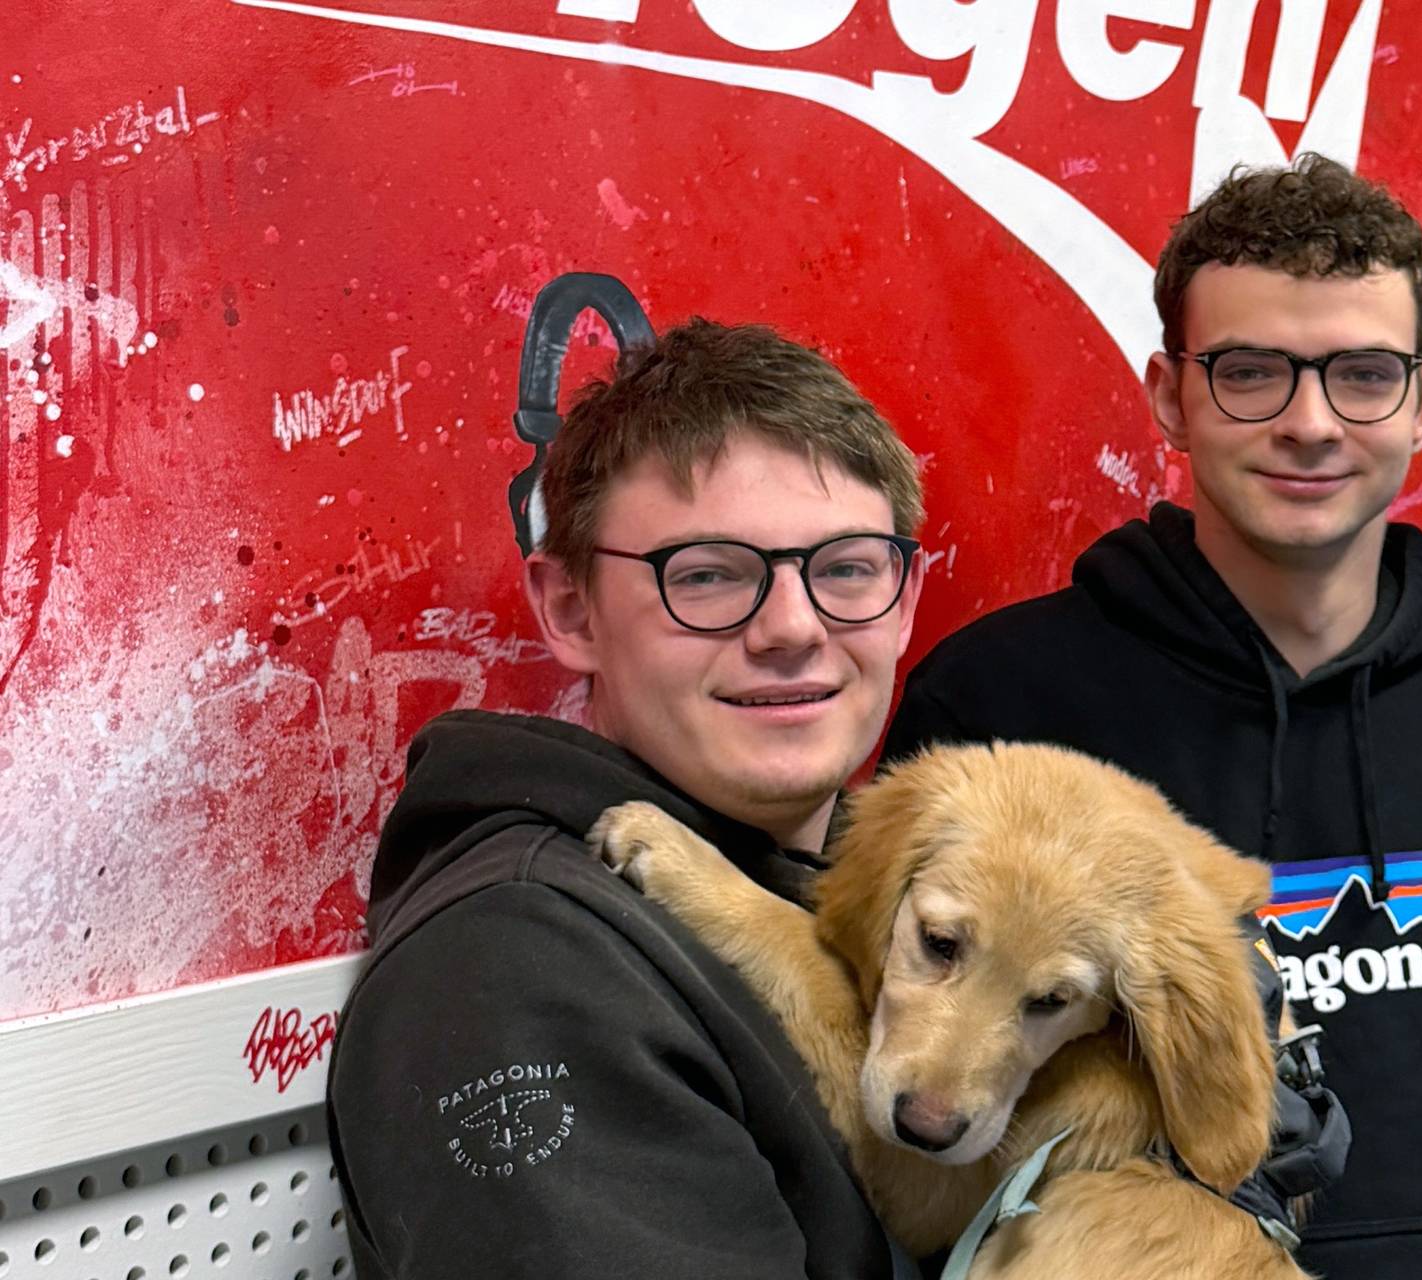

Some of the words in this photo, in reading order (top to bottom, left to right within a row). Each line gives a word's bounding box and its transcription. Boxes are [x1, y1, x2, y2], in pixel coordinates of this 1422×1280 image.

[437, 1062, 570, 1115] PATAGONIA
[448, 1137, 489, 1178] BUILT
[494, 1162, 514, 1177] TO
[525, 1102, 576, 1167] ENDURE
